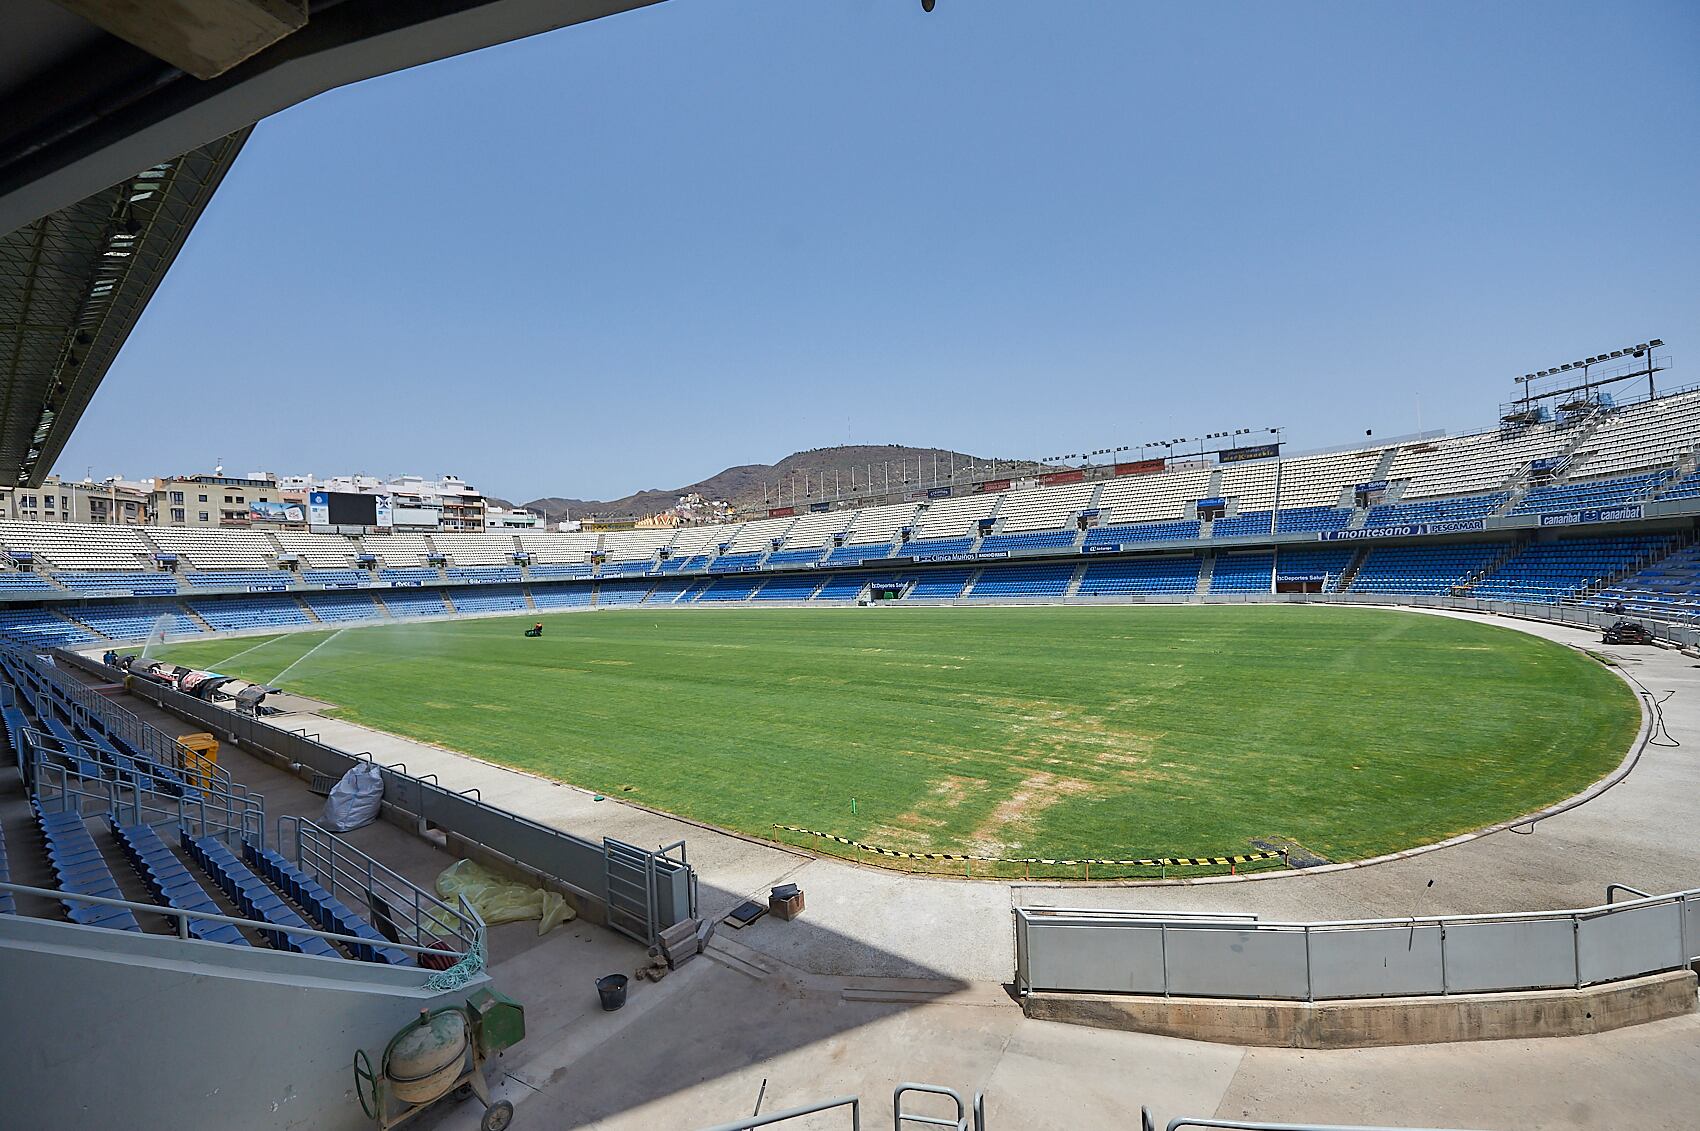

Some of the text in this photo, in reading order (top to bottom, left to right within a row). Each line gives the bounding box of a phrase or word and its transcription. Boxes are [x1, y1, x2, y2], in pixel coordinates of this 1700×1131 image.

[1543, 506, 1640, 525] canaribat canaribat
[1337, 526, 1411, 539] montesano
[1432, 521, 1482, 533] PESCAMAR
